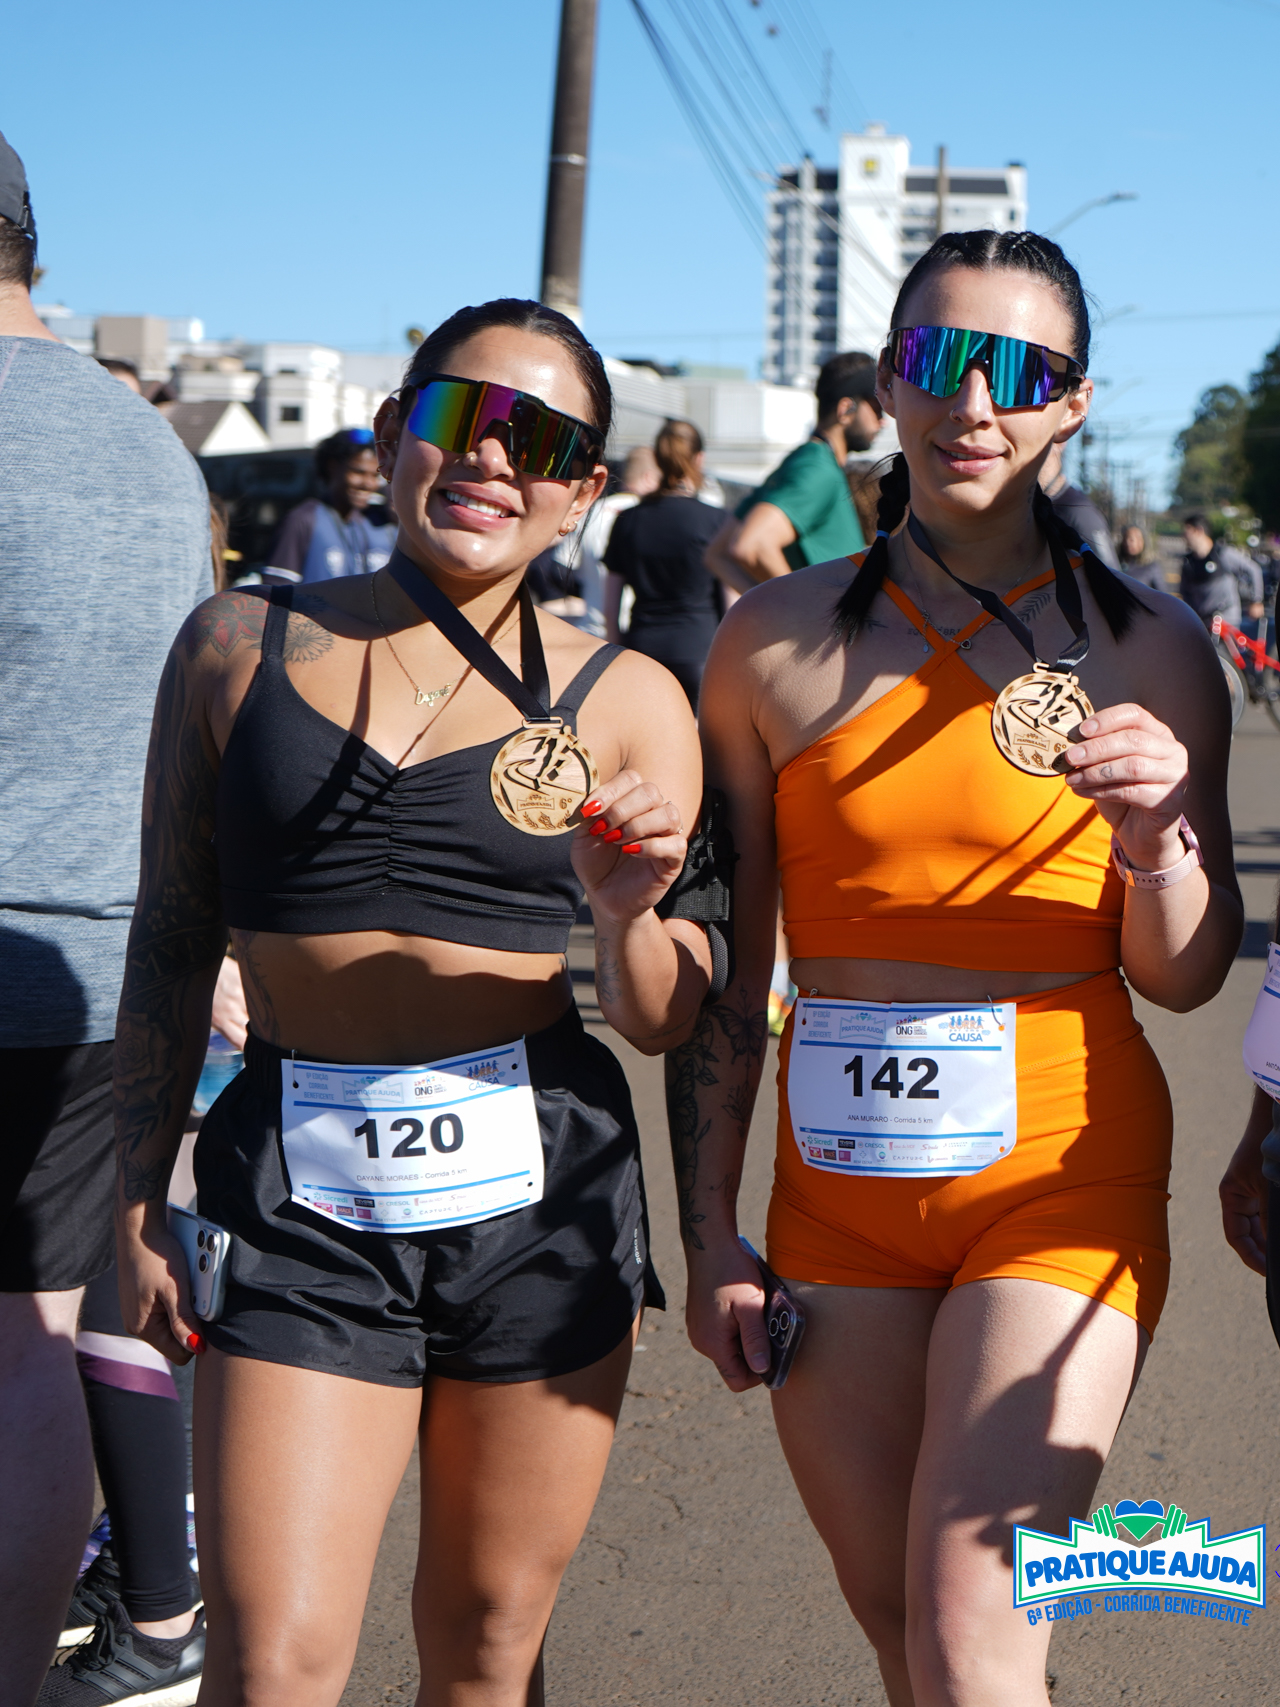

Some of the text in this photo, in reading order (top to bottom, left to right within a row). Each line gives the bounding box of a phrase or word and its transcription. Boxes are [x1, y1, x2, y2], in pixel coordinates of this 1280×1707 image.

[867, 1026, 884, 1035] AJUDA
[896, 1025, 913, 1036] ONG
[948, 1033, 983, 1042] CAUSA
[844, 1055, 939, 1099] 142
[468, 1076, 500, 1091] CAUSA
[378, 1089, 401, 1097] AJUDA
[414, 1085, 433, 1097] ONG
[847, 1114, 860, 1122] ANA
[860, 1115, 889, 1123] MURARO
[893, 1116, 917, 1124] Corrida
[354, 1112, 464, 1159] 120
[813, 1137, 833, 1146] Sicredi
[386, 1174, 419, 1182] MORAES
[323, 1194, 348, 1203] Sicredi
